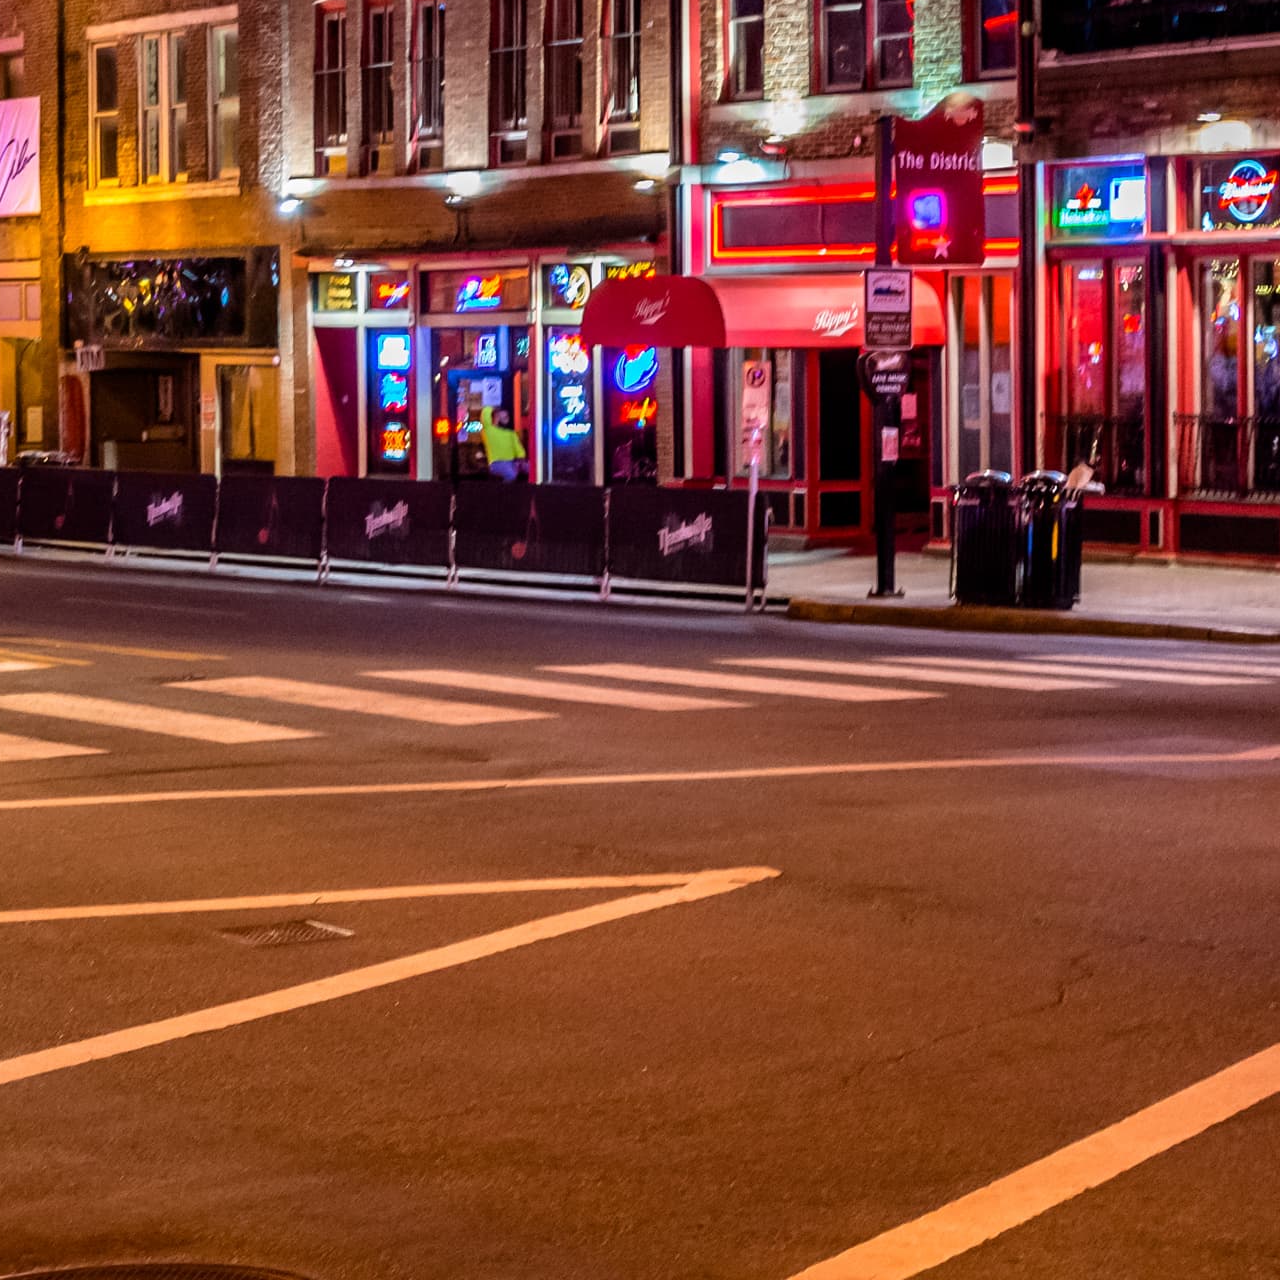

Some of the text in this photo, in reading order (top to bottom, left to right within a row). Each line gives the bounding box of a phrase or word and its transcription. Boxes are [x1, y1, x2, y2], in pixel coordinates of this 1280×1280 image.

[897, 150, 925, 170] The
[632, 290, 670, 322] Rippy's
[812, 301, 859, 334] Rippy's
